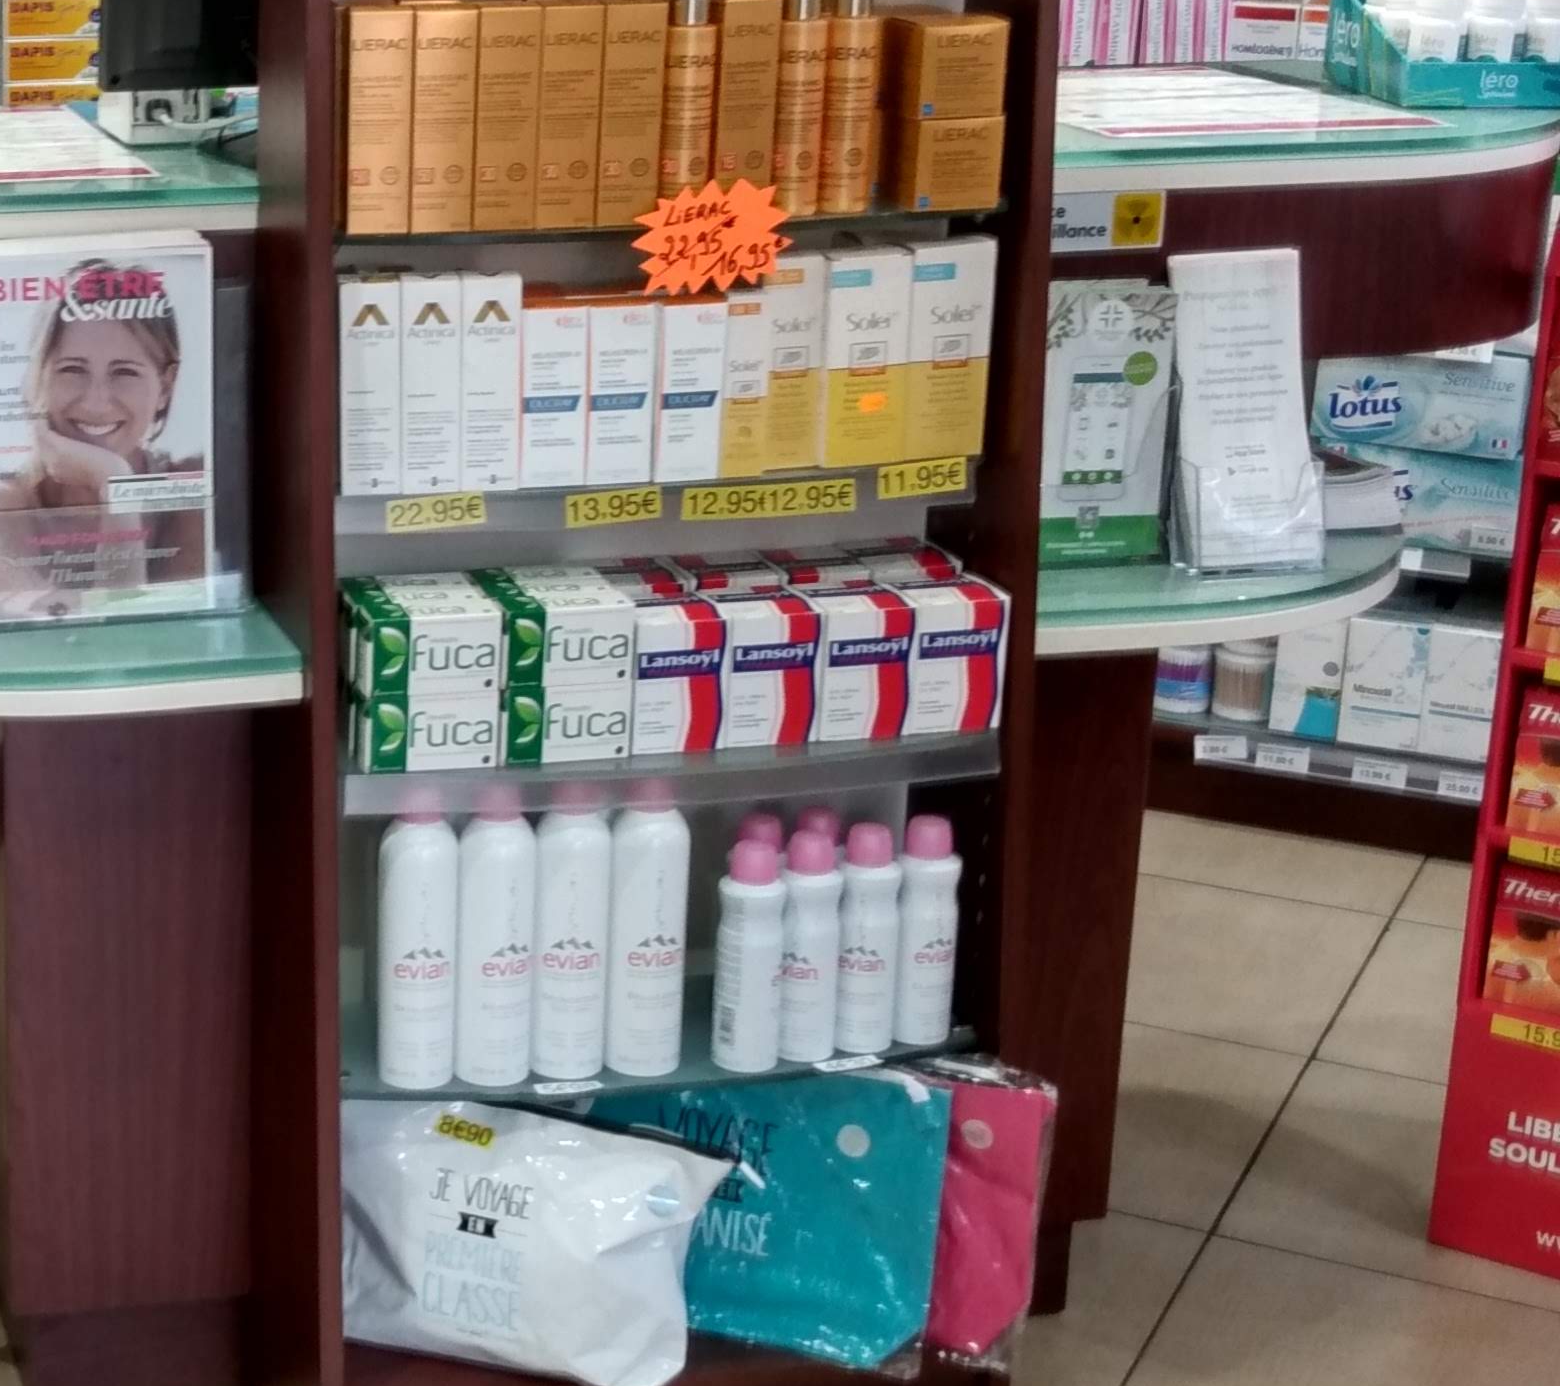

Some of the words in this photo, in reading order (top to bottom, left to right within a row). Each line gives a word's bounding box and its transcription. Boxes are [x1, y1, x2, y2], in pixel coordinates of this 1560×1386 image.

[1481, 71, 1518, 90] léro
[1329, 391, 1402, 417] lotus
[881, 464, 963, 491] 11.95€
[568, 492, 658, 520] 13.95€
[767, 483, 852, 512] 12.95€
[390, 498, 482, 527] 22.95€
[411, 633, 495, 671] fuca
[547, 630, 629, 666] fuca
[409, 708, 493, 747] fuca
[546, 702, 629, 743] fuca
[394, 955, 451, 982] evian
[543, 949, 601, 974] evian
[628, 945, 682, 971] evian
[438, 1116, 494, 1146] 8€90
[430, 1169, 454, 1202] JE
[464, 1177, 534, 1219] VOYAGE
[422, 1276, 518, 1332] CLASSE
